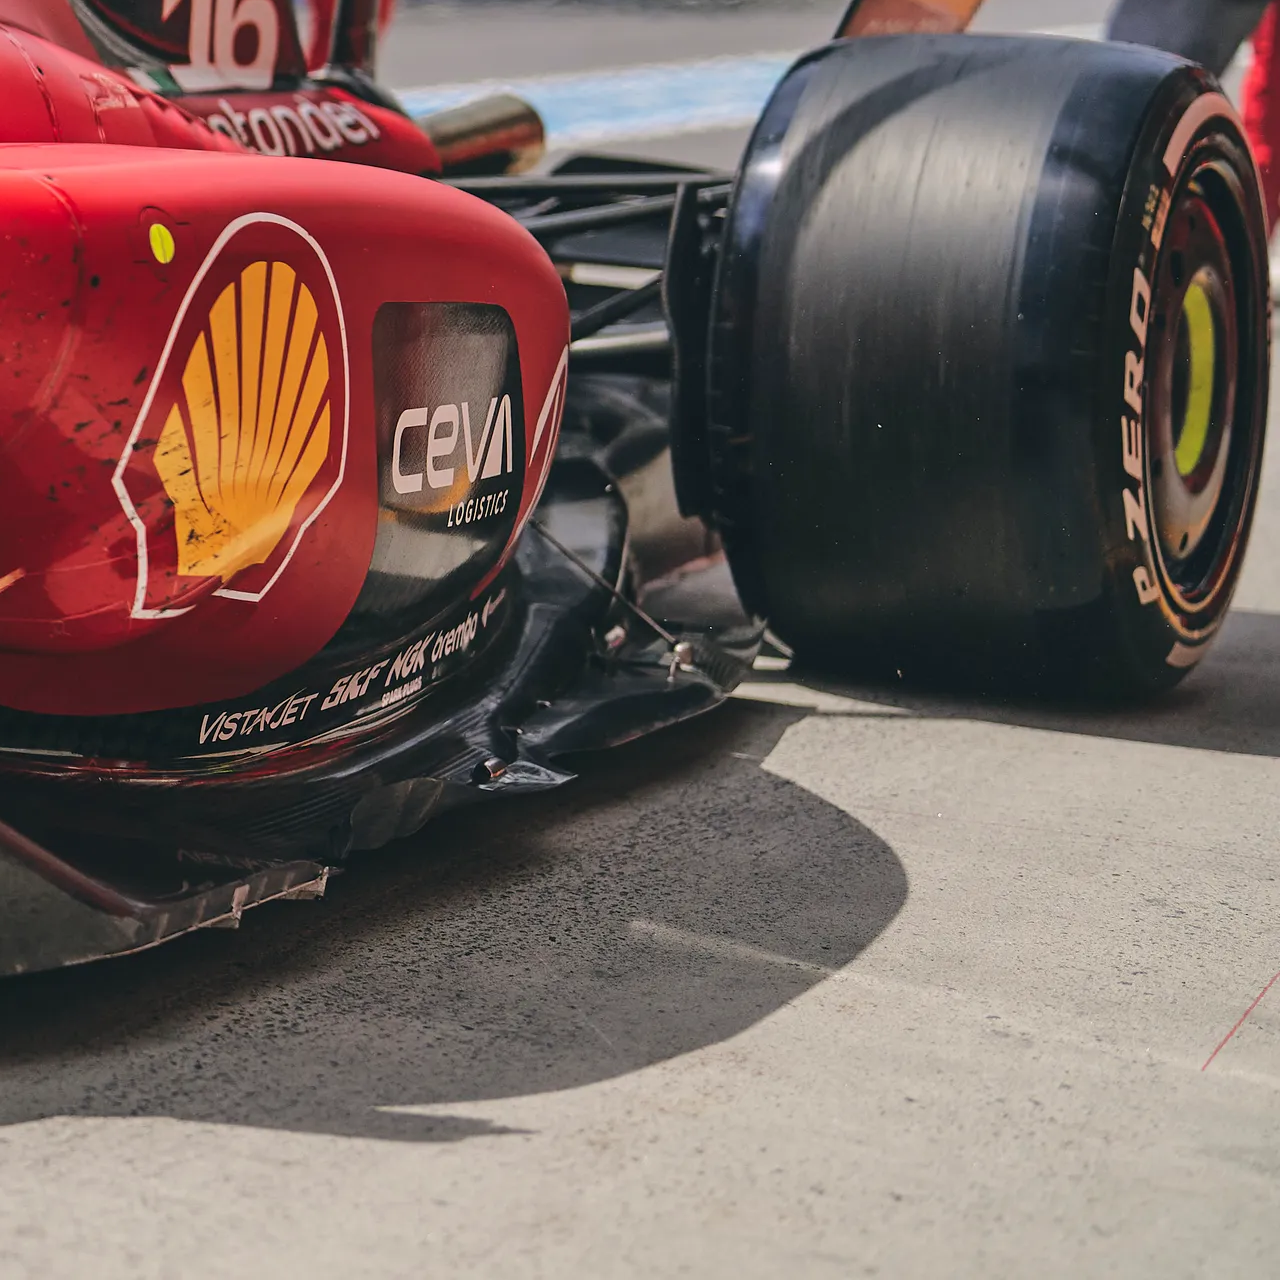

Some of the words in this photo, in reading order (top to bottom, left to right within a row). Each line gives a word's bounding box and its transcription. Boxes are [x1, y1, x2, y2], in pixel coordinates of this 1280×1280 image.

[392, 394, 513, 494] CEVA
[447, 489, 509, 528] LOGISTICS
[198, 687, 320, 744] VISTAJET
[320, 658, 391, 711] SKF
[383, 631, 437, 687] NGK
[431, 612, 479, 661] brembo
